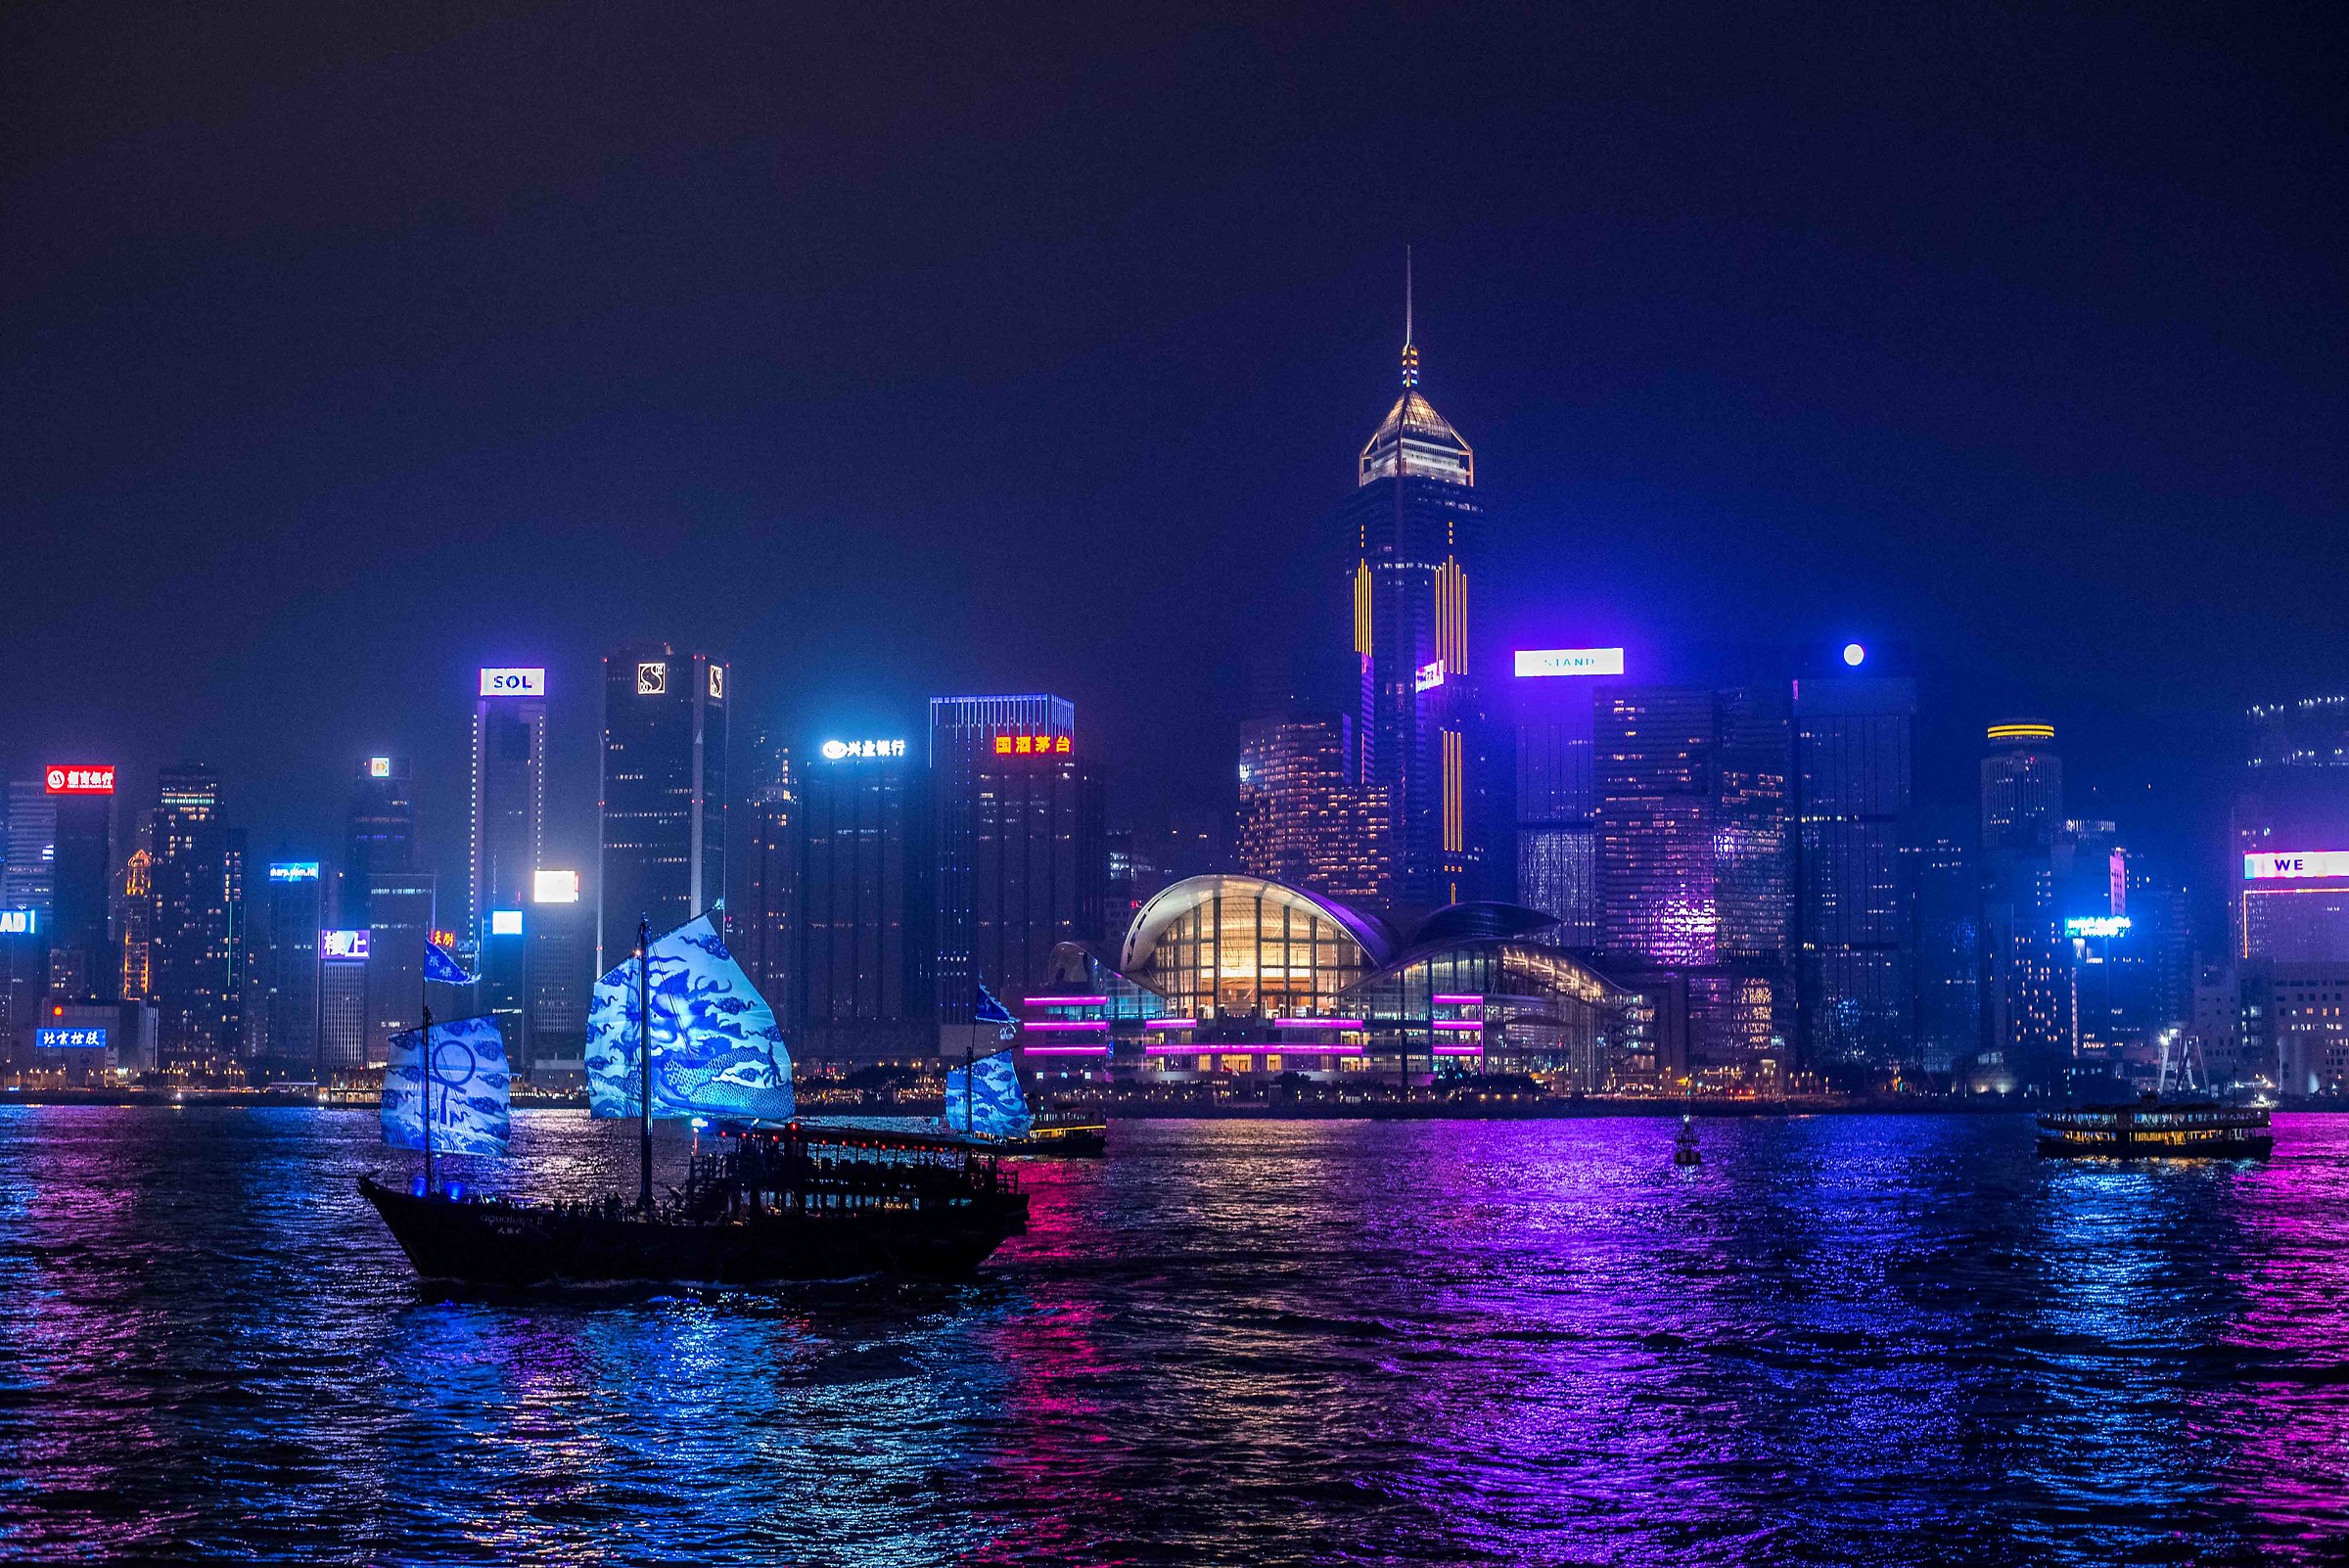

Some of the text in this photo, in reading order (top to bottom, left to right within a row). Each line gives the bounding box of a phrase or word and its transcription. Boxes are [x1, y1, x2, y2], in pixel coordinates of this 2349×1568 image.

[493, 675, 532, 689] SOL
[995, 736, 1071, 754] 国酒茅台
[2274, 859, 2303, 871] WE
